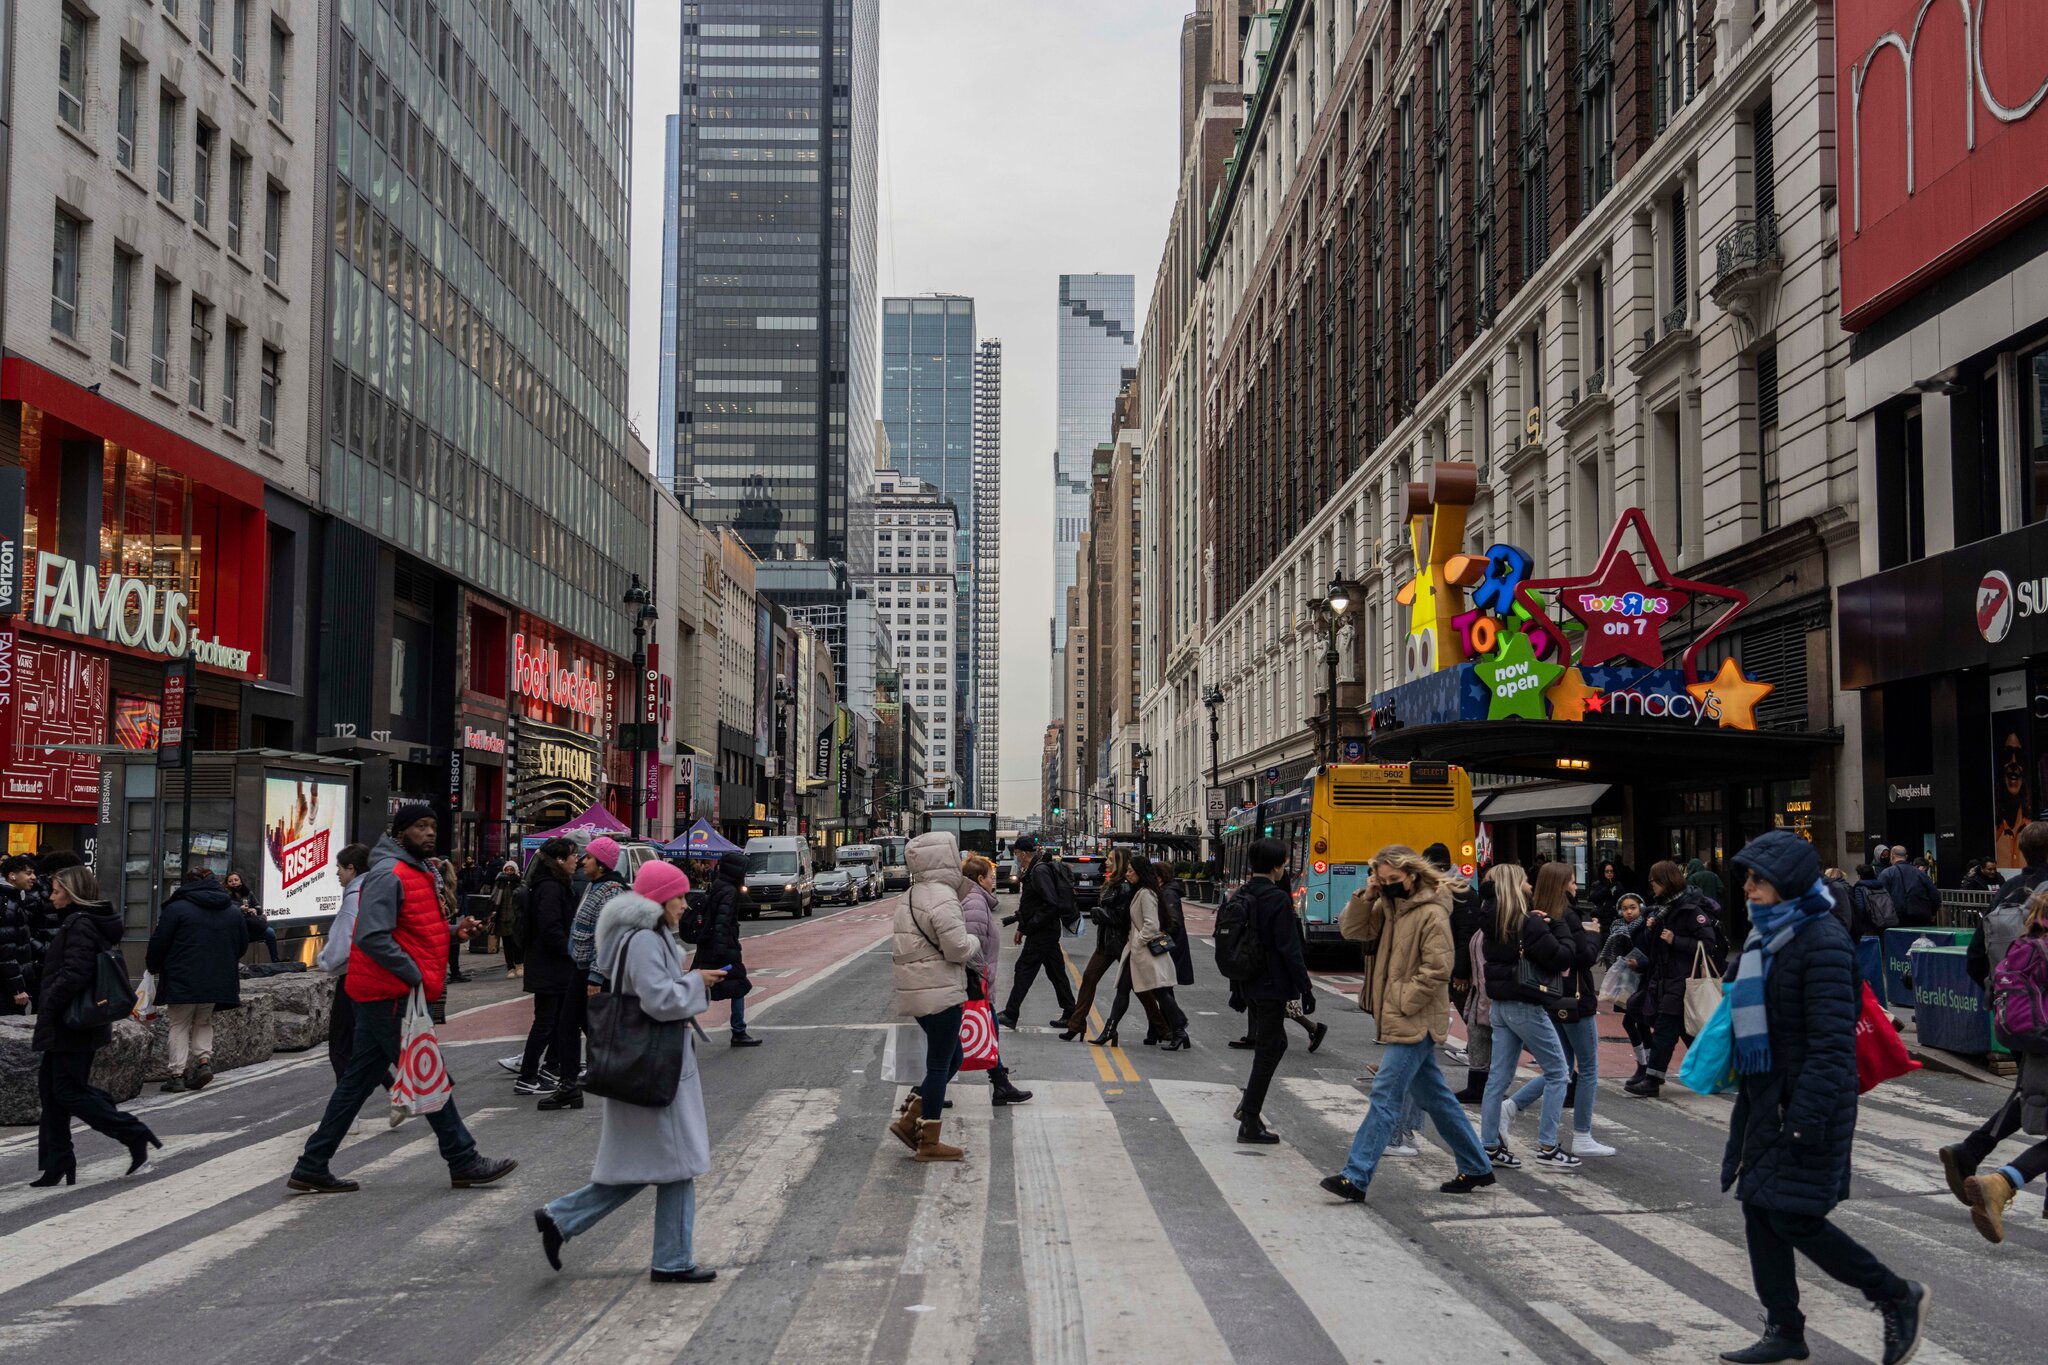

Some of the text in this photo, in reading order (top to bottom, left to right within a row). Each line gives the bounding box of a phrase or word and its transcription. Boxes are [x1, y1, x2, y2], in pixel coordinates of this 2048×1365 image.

[0, 541, 14, 608] verizon
[34, 551, 188, 657] FAMOUS
[1603, 618, 1648, 635] on 7
[190, 628, 251, 672] footwear
[17, 653, 33, 669] VANS
[1495, 661, 1529, 682] now
[512, 633, 597, 717] Foot Locker
[1496, 674, 1539, 698] open
[334, 723, 357, 738] 112
[819, 738, 829, 757] OLD
[450, 751, 461, 794] TISSOT
[540, 742, 592, 783] SEPHORA
[681, 757, 692, 778] 30
[1383, 770, 1404, 779] 5602
[102, 771, 112, 824] Newsstand
[1897, 783, 1931, 801] sunglass hut
[1210, 800, 1224, 810] 25
[1787, 802, 1801, 812] LOUIS
[1915, 985, 1978, 1014] Herald Square
